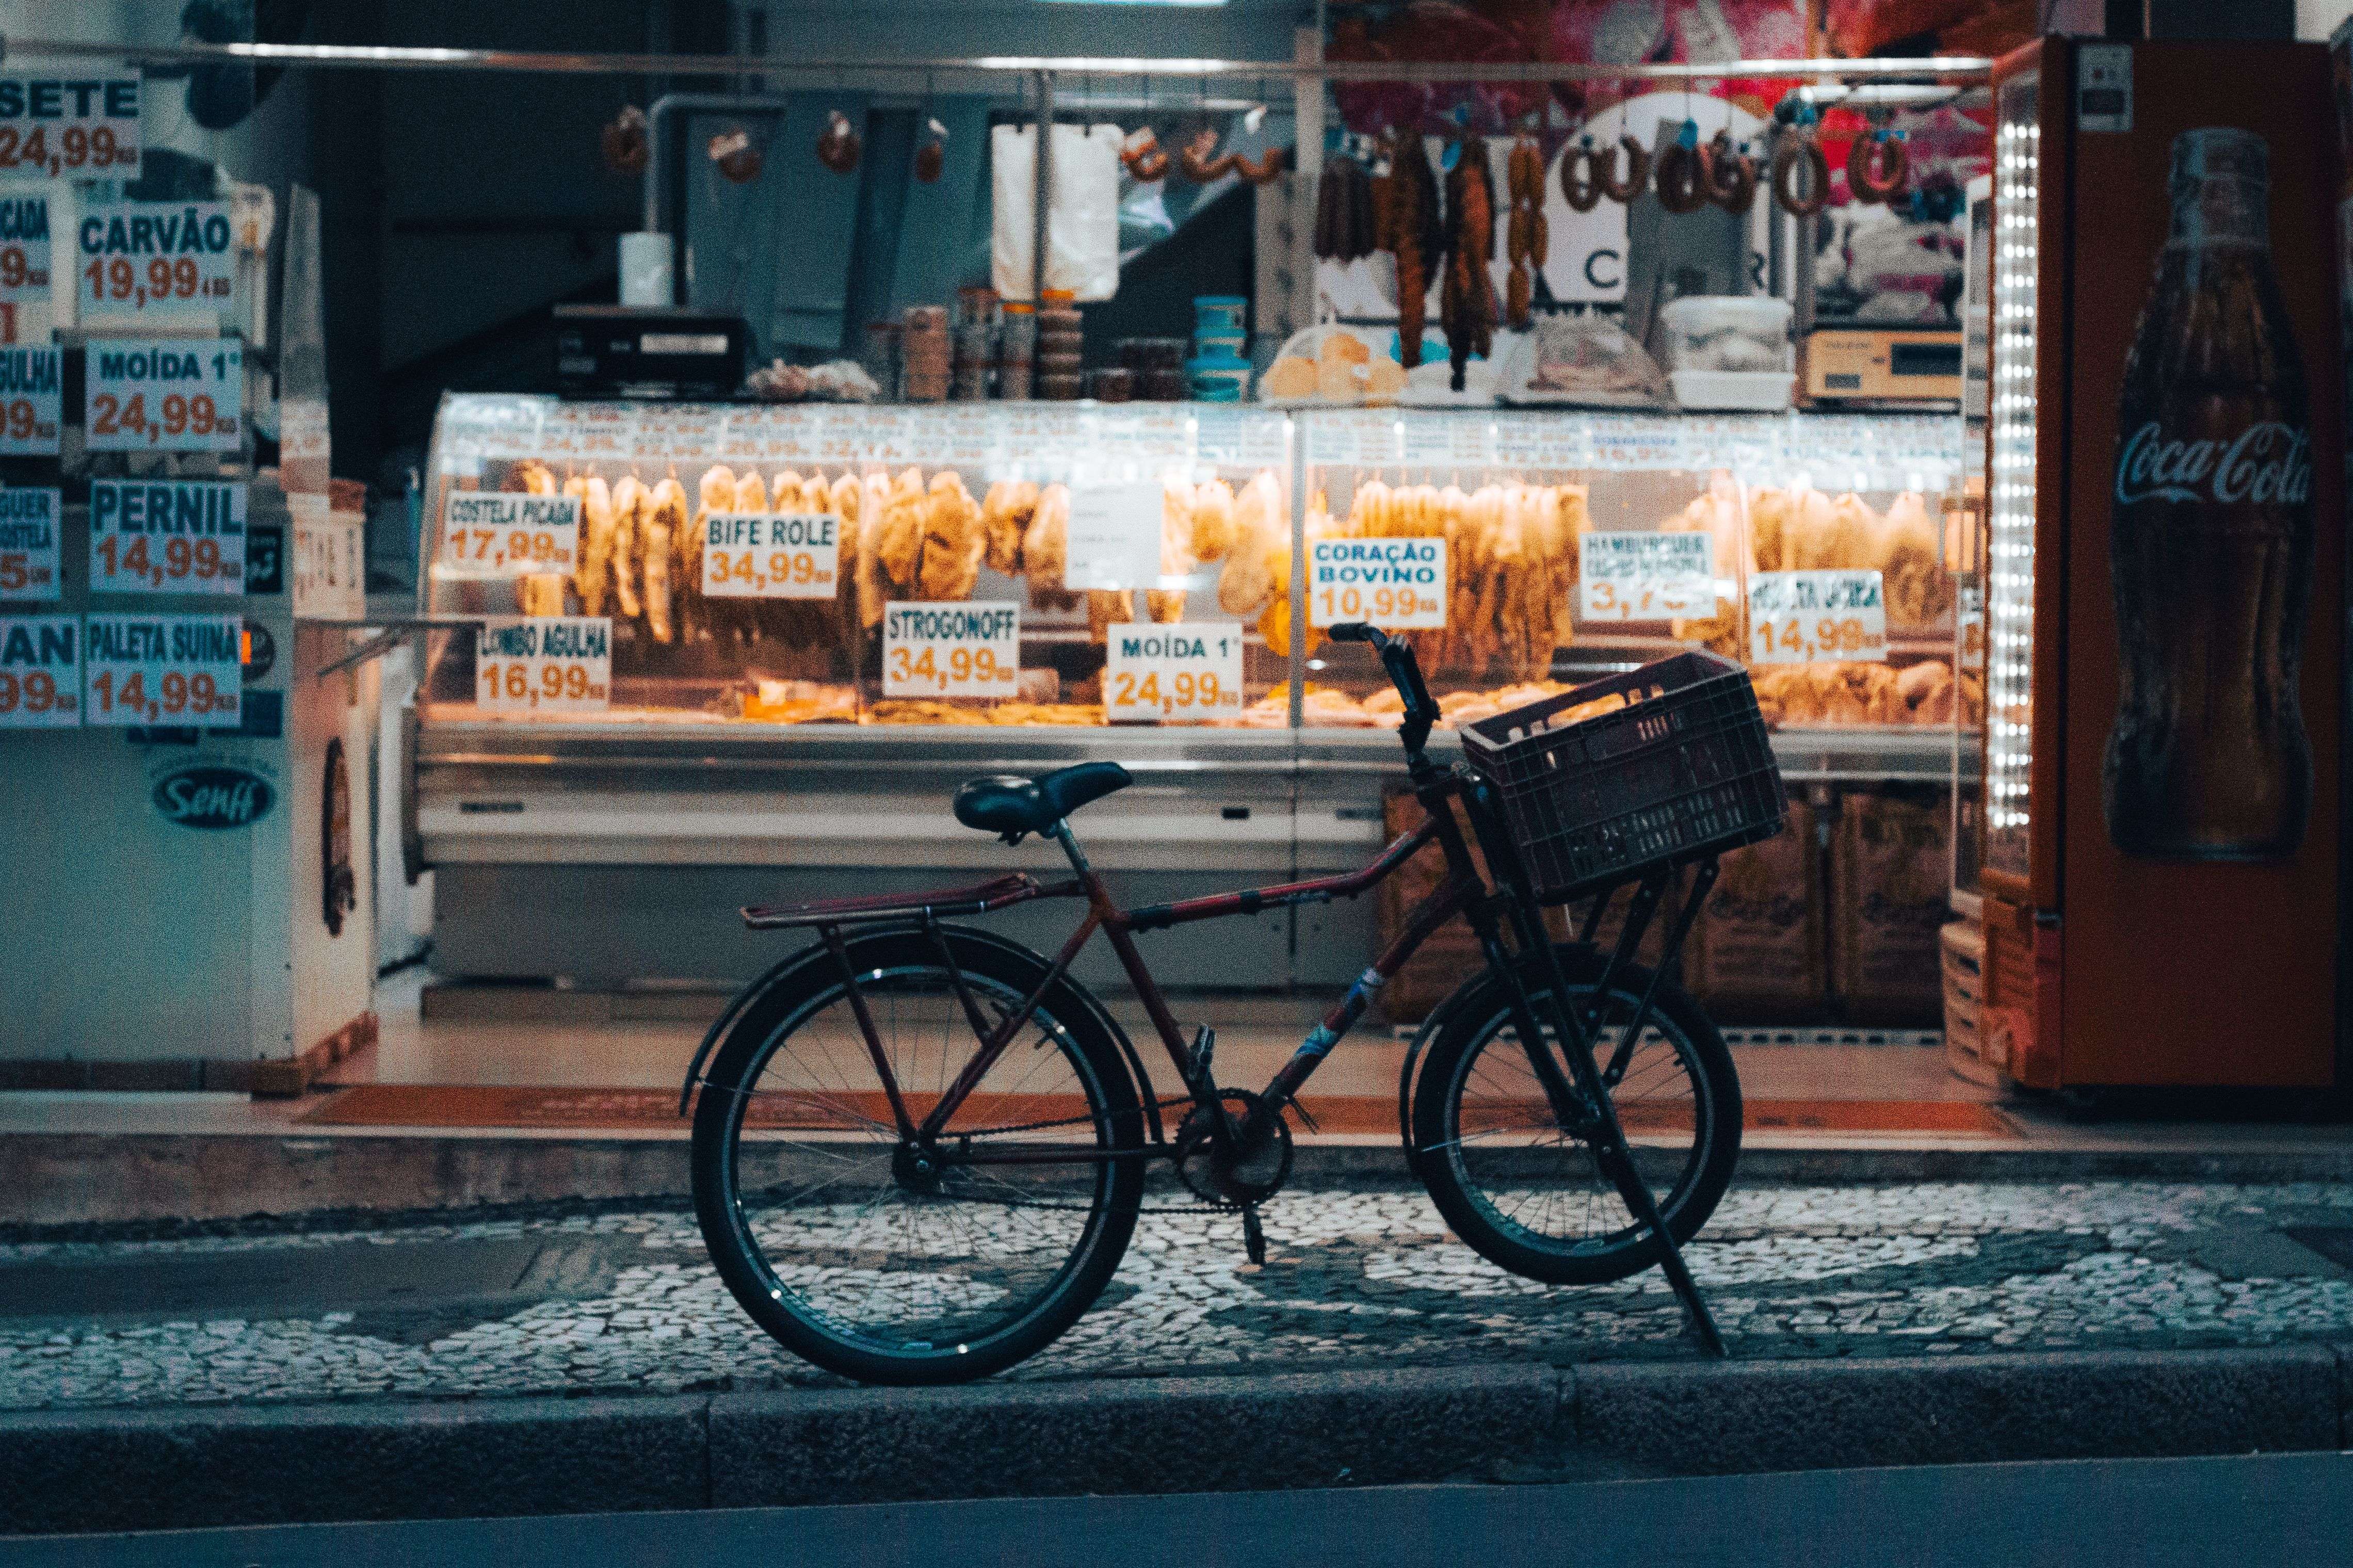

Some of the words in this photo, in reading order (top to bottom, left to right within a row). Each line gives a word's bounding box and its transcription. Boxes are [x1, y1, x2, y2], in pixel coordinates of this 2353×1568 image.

[0, 81, 138, 118] SETE
[80, 207, 230, 253] CARVÃO
[85, 259, 197, 311] 19,99
[101, 349, 202, 380] MOÍDA
[93, 394, 215, 444] 24,99
[2117, 421, 2311, 504] Coca-Cola
[93, 485, 243, 534] PERNIL
[450, 528, 556, 567] 17,99
[708, 519, 762, 545] BIFE
[771, 519, 833, 546] ROLE
[98, 535, 219, 587] 14,99
[710, 551, 815, 592] 34,99
[1315, 542, 1436, 565] CORAÇÃO
[1318, 567, 1436, 584] BOVINO
[889, 609, 1015, 640] STROGONOFF
[1319, 587, 1417, 622] 10,99
[89, 624, 167, 661] PALETA
[173, 624, 239, 662] SUINA
[1121, 632, 1206, 659] MOÍDA
[1756, 619, 1864, 659] 14,99
[482, 664, 588, 707] 16,99
[890, 646, 996, 690] 34,99
[94, 672, 215, 722] 14,99
[1115, 672, 1220, 715] 24,99
